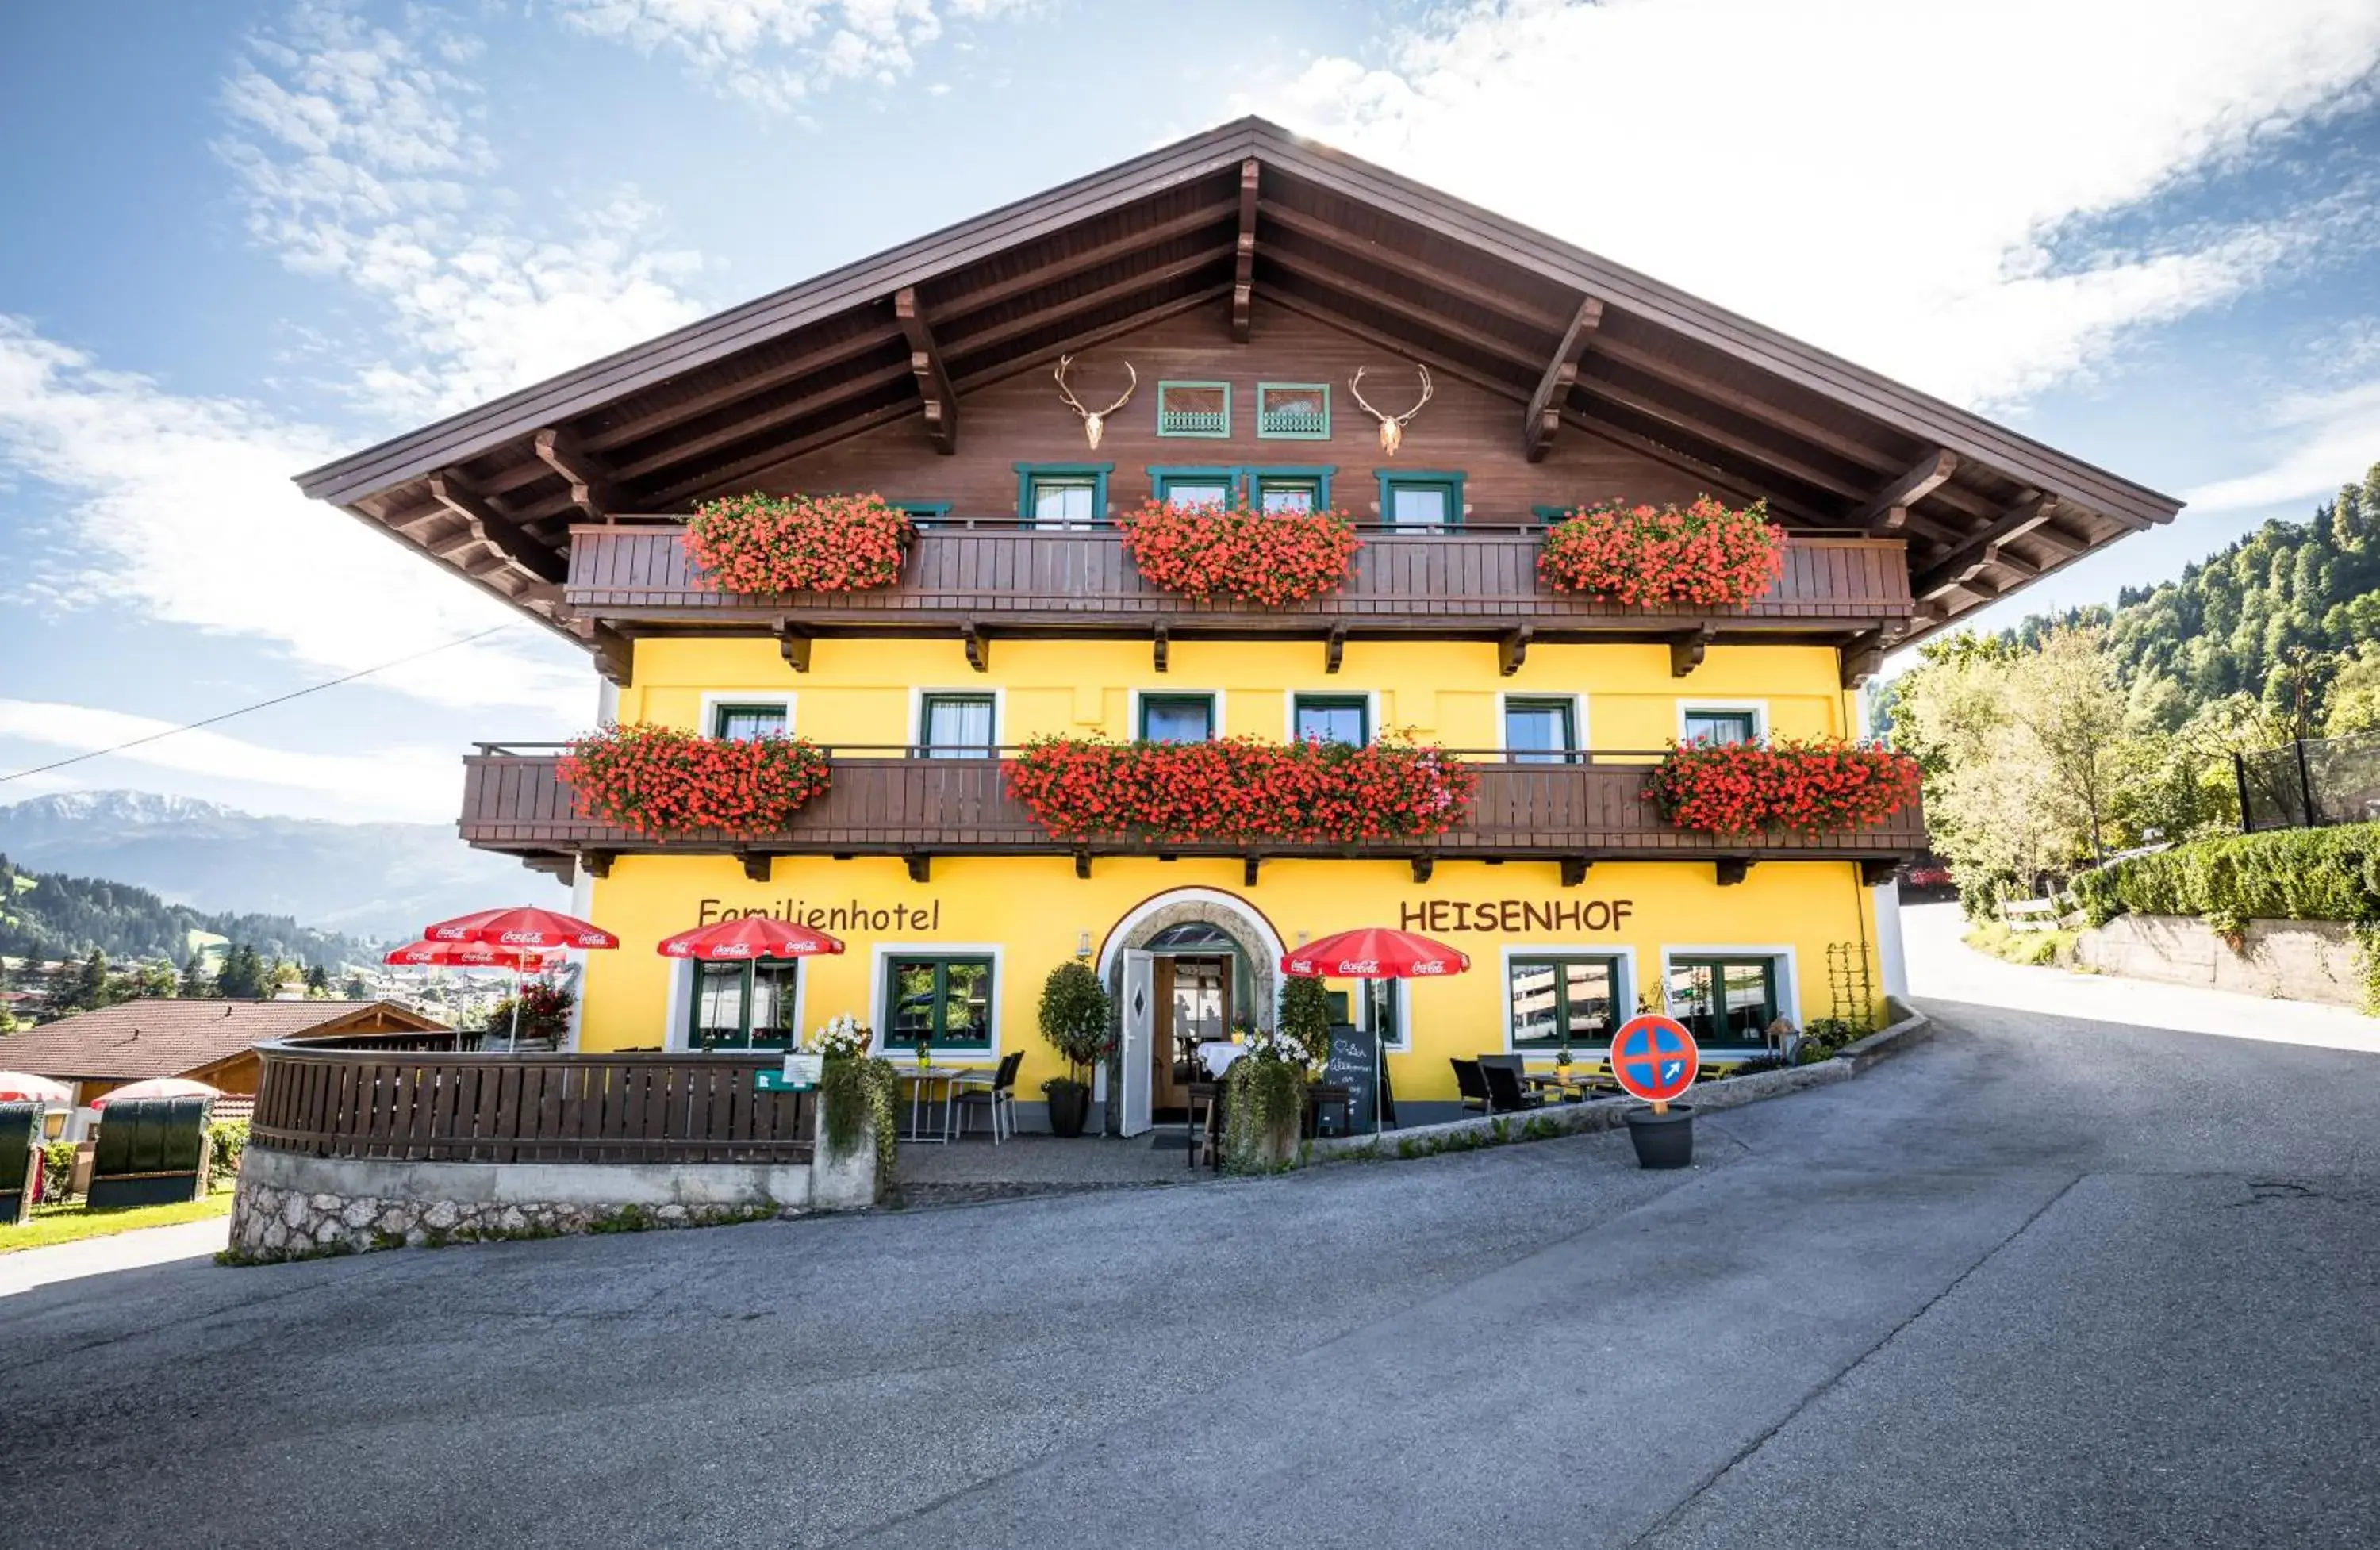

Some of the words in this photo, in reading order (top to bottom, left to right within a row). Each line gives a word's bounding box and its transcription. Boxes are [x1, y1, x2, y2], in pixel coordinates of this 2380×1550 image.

[698, 898, 939, 930] Familienhotel
[1400, 900, 1633, 932] HEISENHOF
[501, 930, 543, 943] Coca-Cola
[1339, 959, 1380, 973] Coca-Cola
